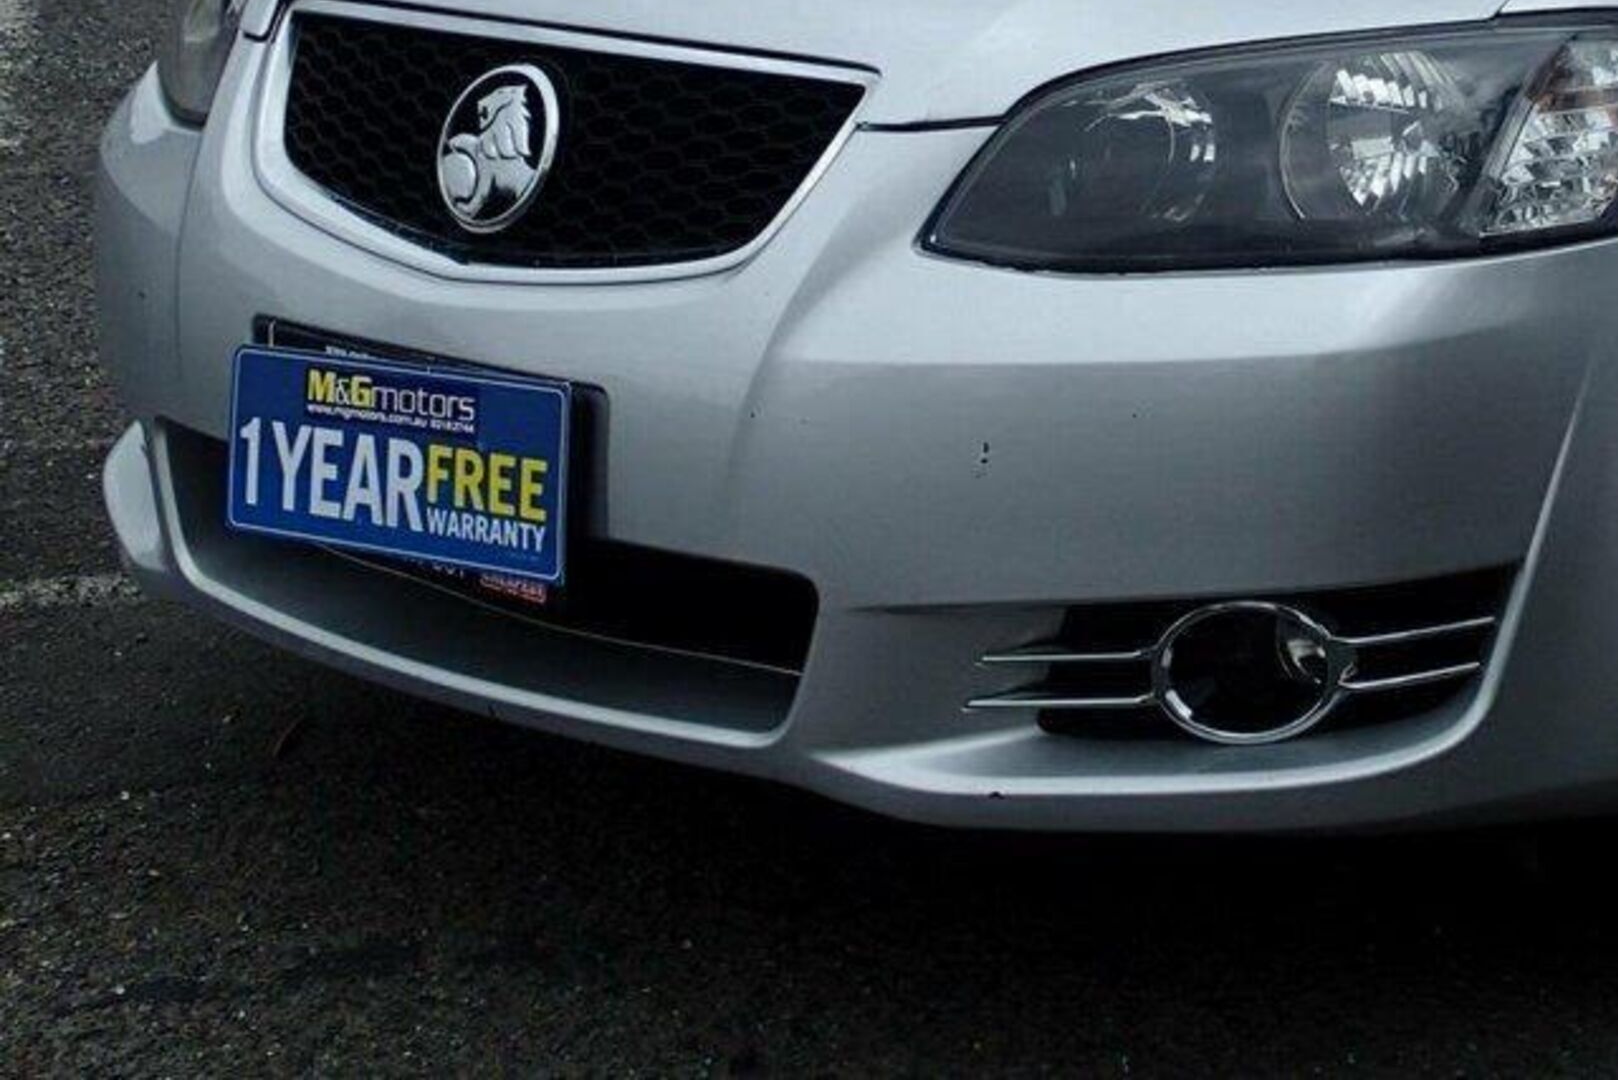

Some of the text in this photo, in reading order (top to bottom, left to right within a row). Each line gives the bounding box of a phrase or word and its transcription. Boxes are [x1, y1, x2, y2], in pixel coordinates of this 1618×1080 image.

[239, 416, 548, 532] 1 YEAR FREE
[426, 507, 546, 552] WARRANTY
